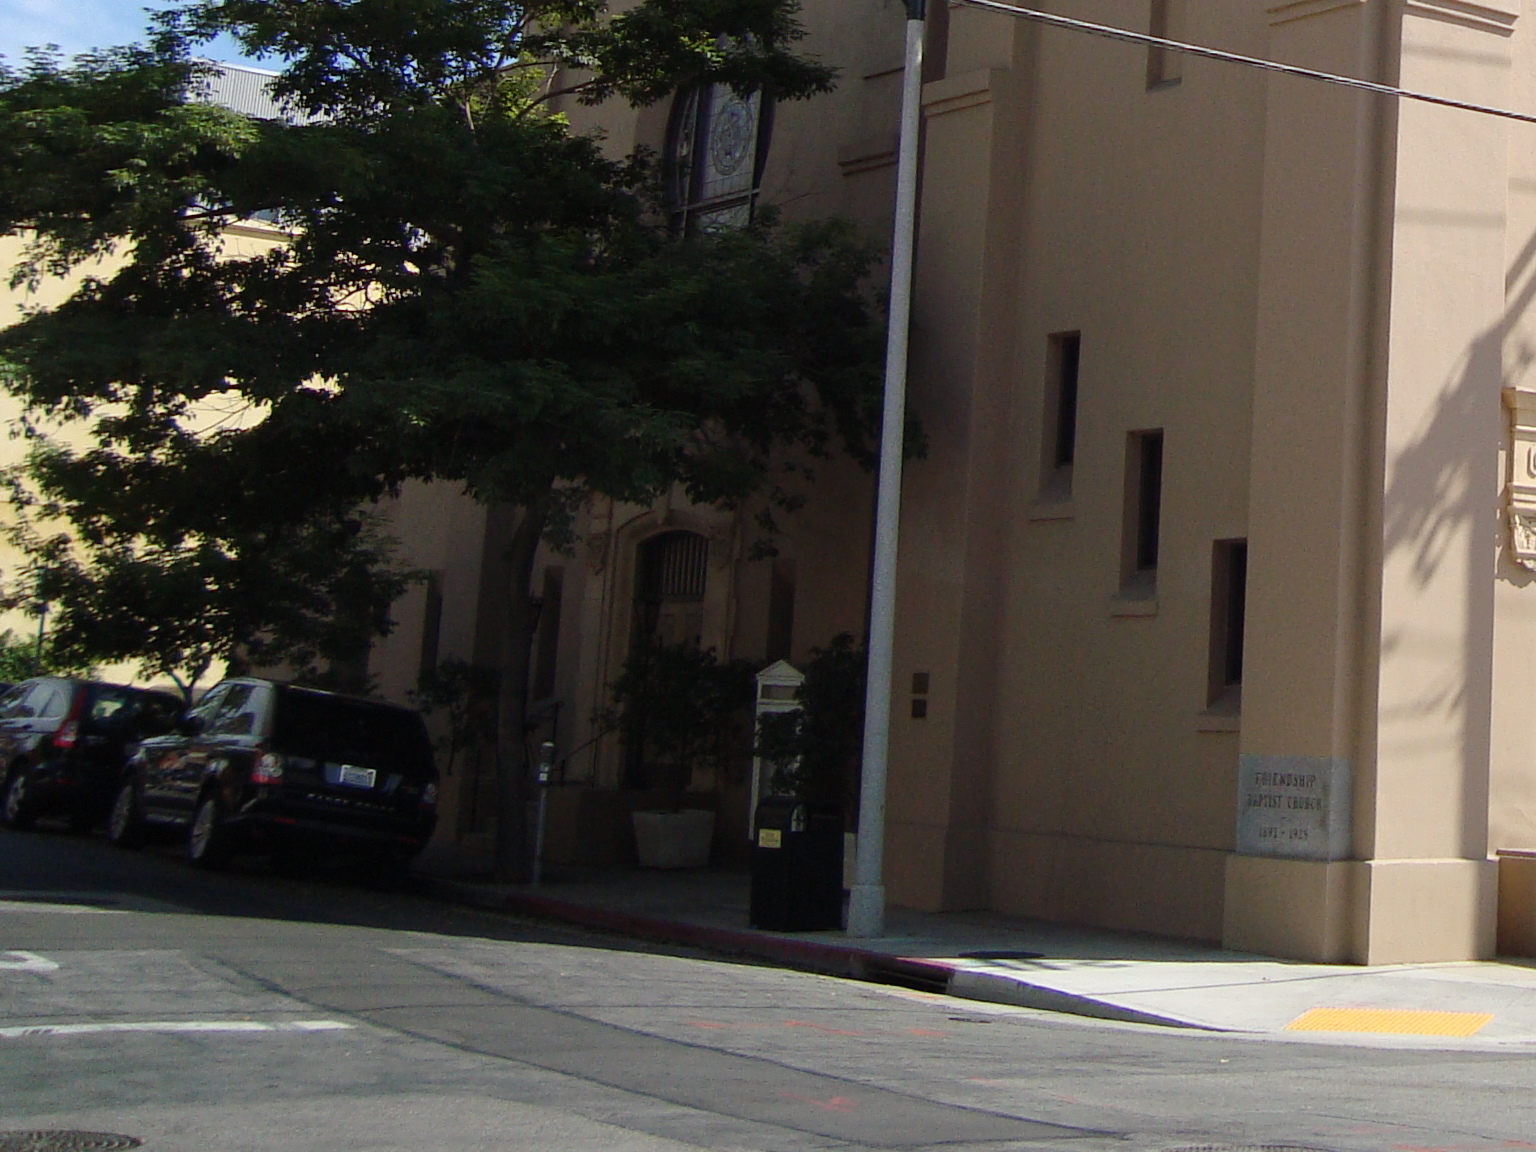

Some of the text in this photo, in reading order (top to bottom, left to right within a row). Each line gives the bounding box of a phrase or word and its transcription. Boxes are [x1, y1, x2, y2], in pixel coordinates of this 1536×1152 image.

[1254, 772, 1317, 788] FRIENDSHIP
[1247, 793, 1322, 811] BAPTIST CHURCH
